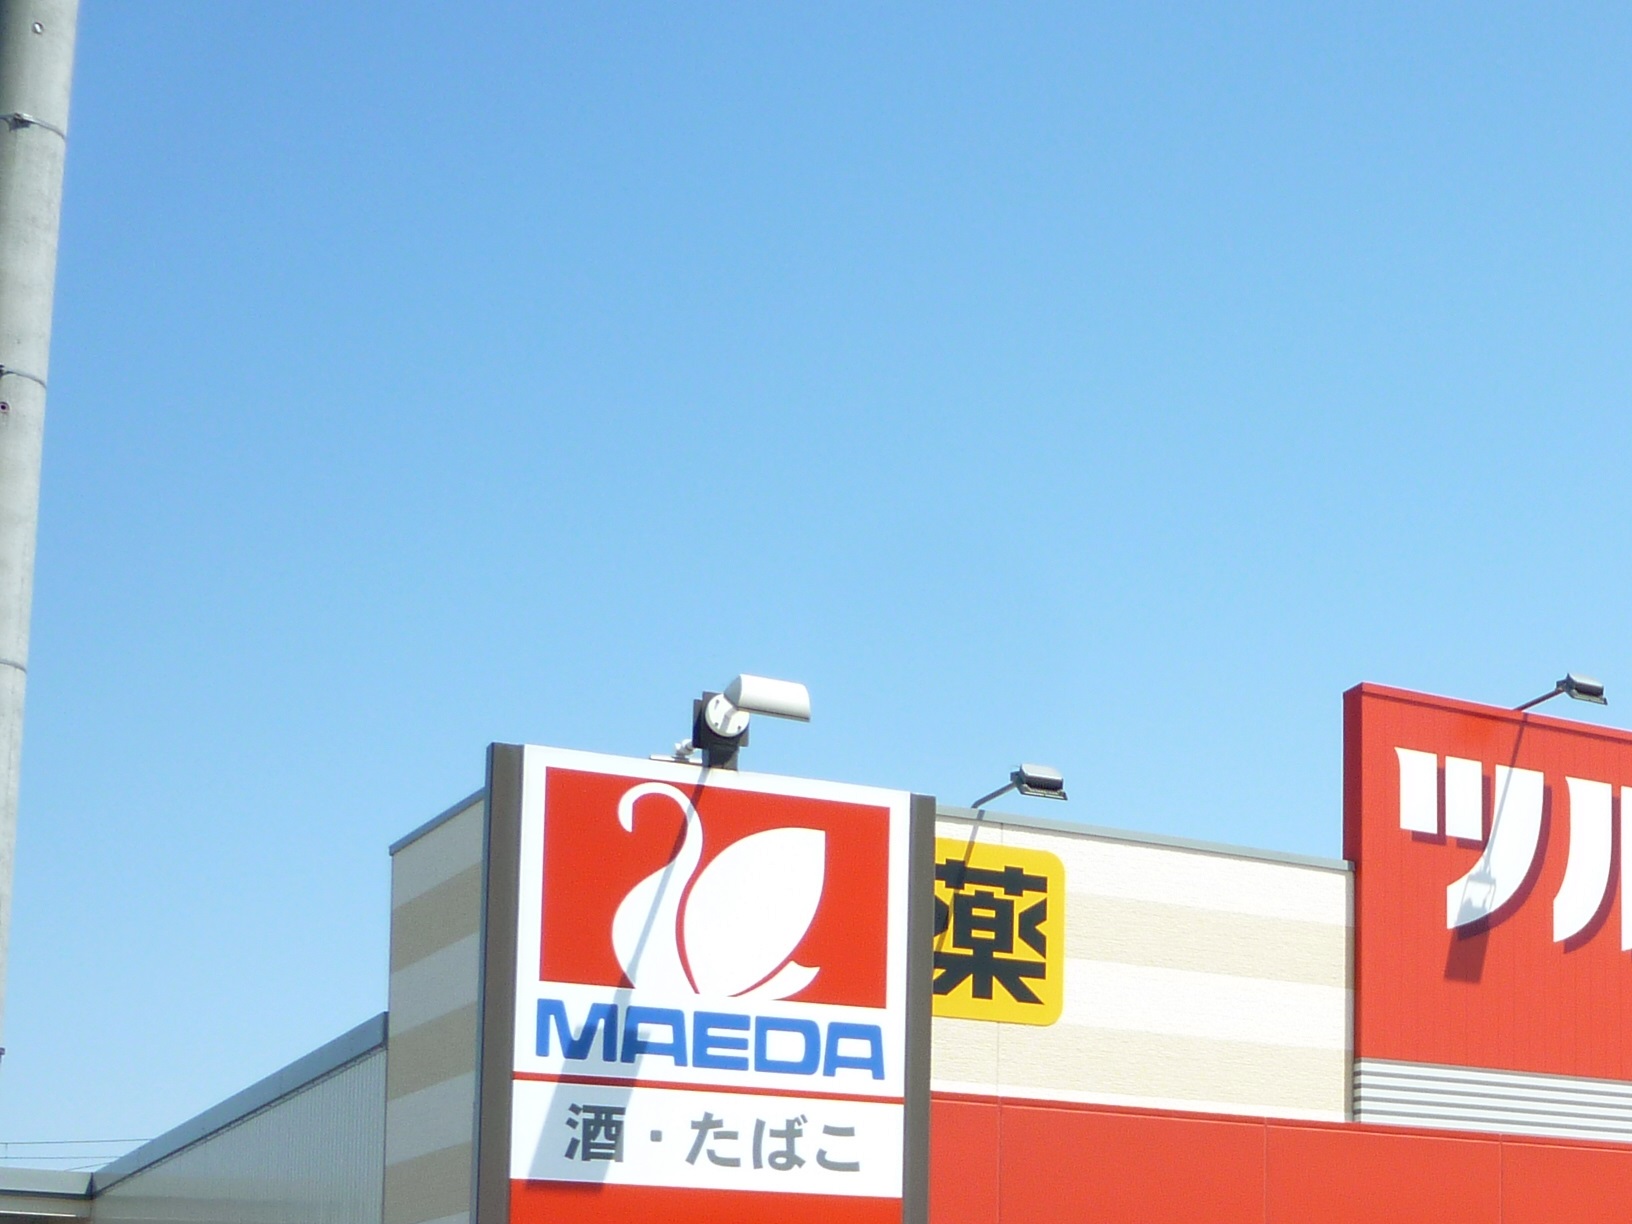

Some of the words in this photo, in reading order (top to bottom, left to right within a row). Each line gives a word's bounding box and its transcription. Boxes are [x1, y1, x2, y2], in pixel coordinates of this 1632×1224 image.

[932, 858, 1047, 1006] 薬
[536, 998, 886, 1081] MAEDA
[564, 1102, 861, 1173] 酒・たばこ
